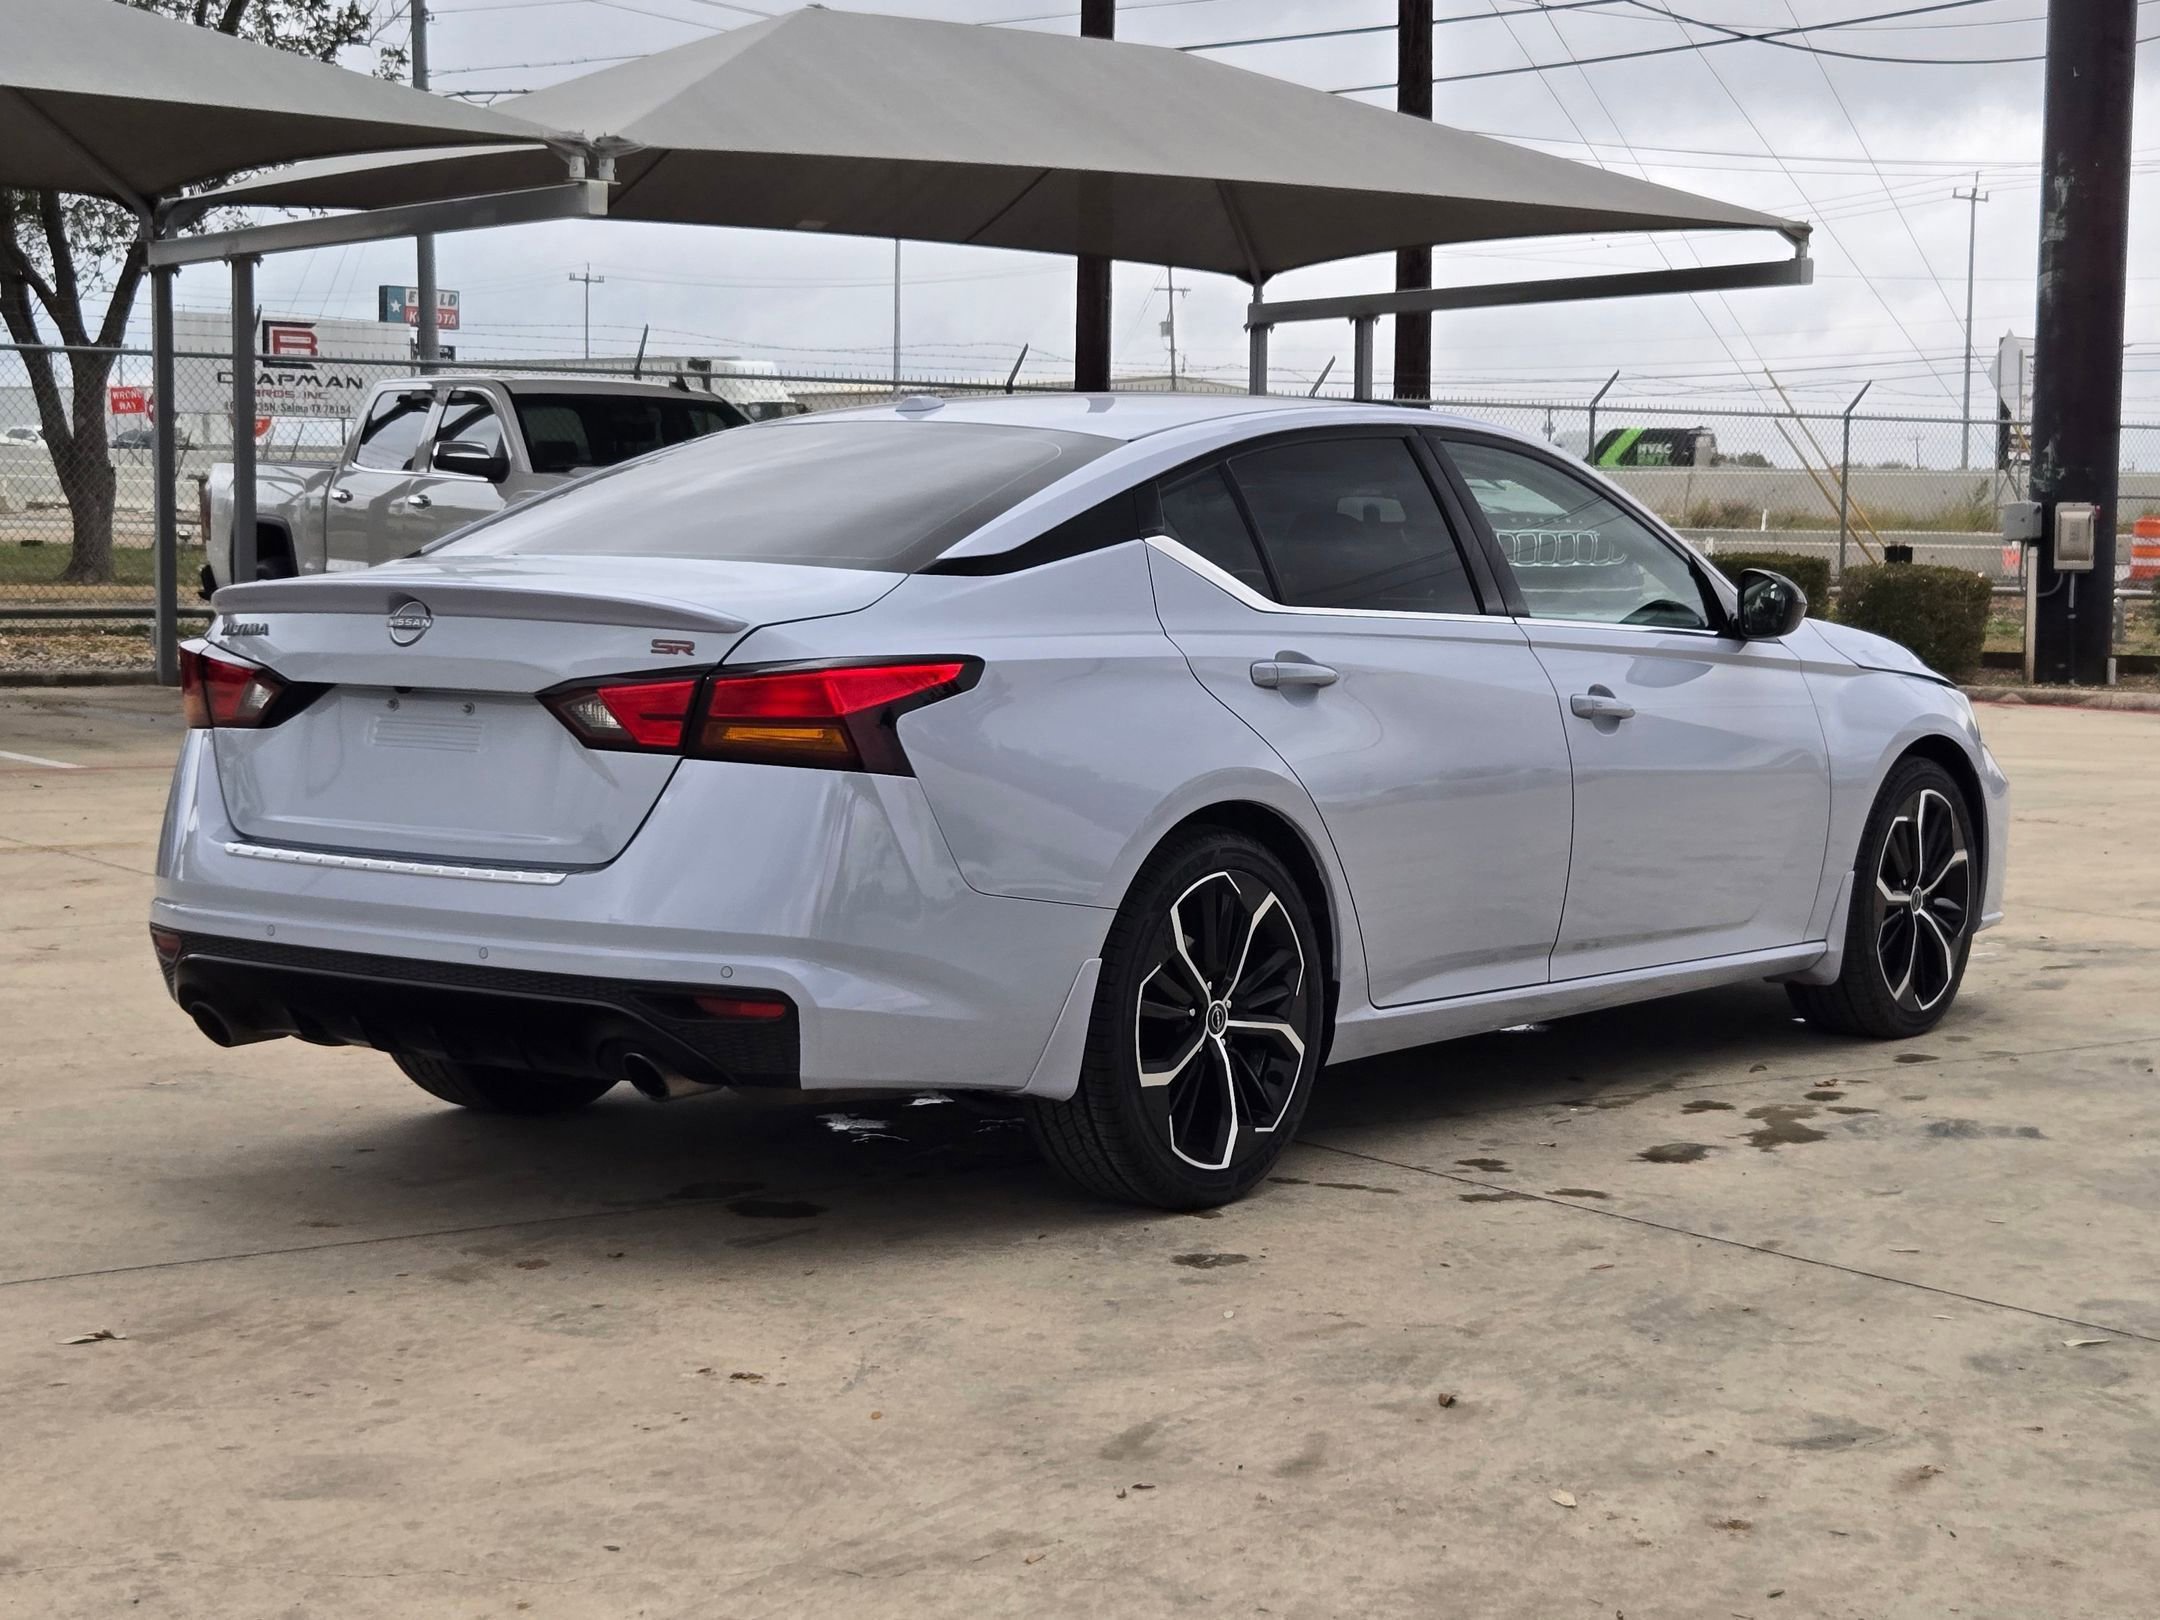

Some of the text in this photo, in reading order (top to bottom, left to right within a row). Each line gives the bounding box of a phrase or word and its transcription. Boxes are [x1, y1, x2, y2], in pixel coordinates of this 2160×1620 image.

[408, 290, 457, 306] ELD
[217, 372, 363, 390] CAPMAN
[119, 401, 138, 411] WAY
[312, 404, 323, 414] TX
[1637, 442, 1673, 455] HVAC
[651, 639, 695, 657] SR
